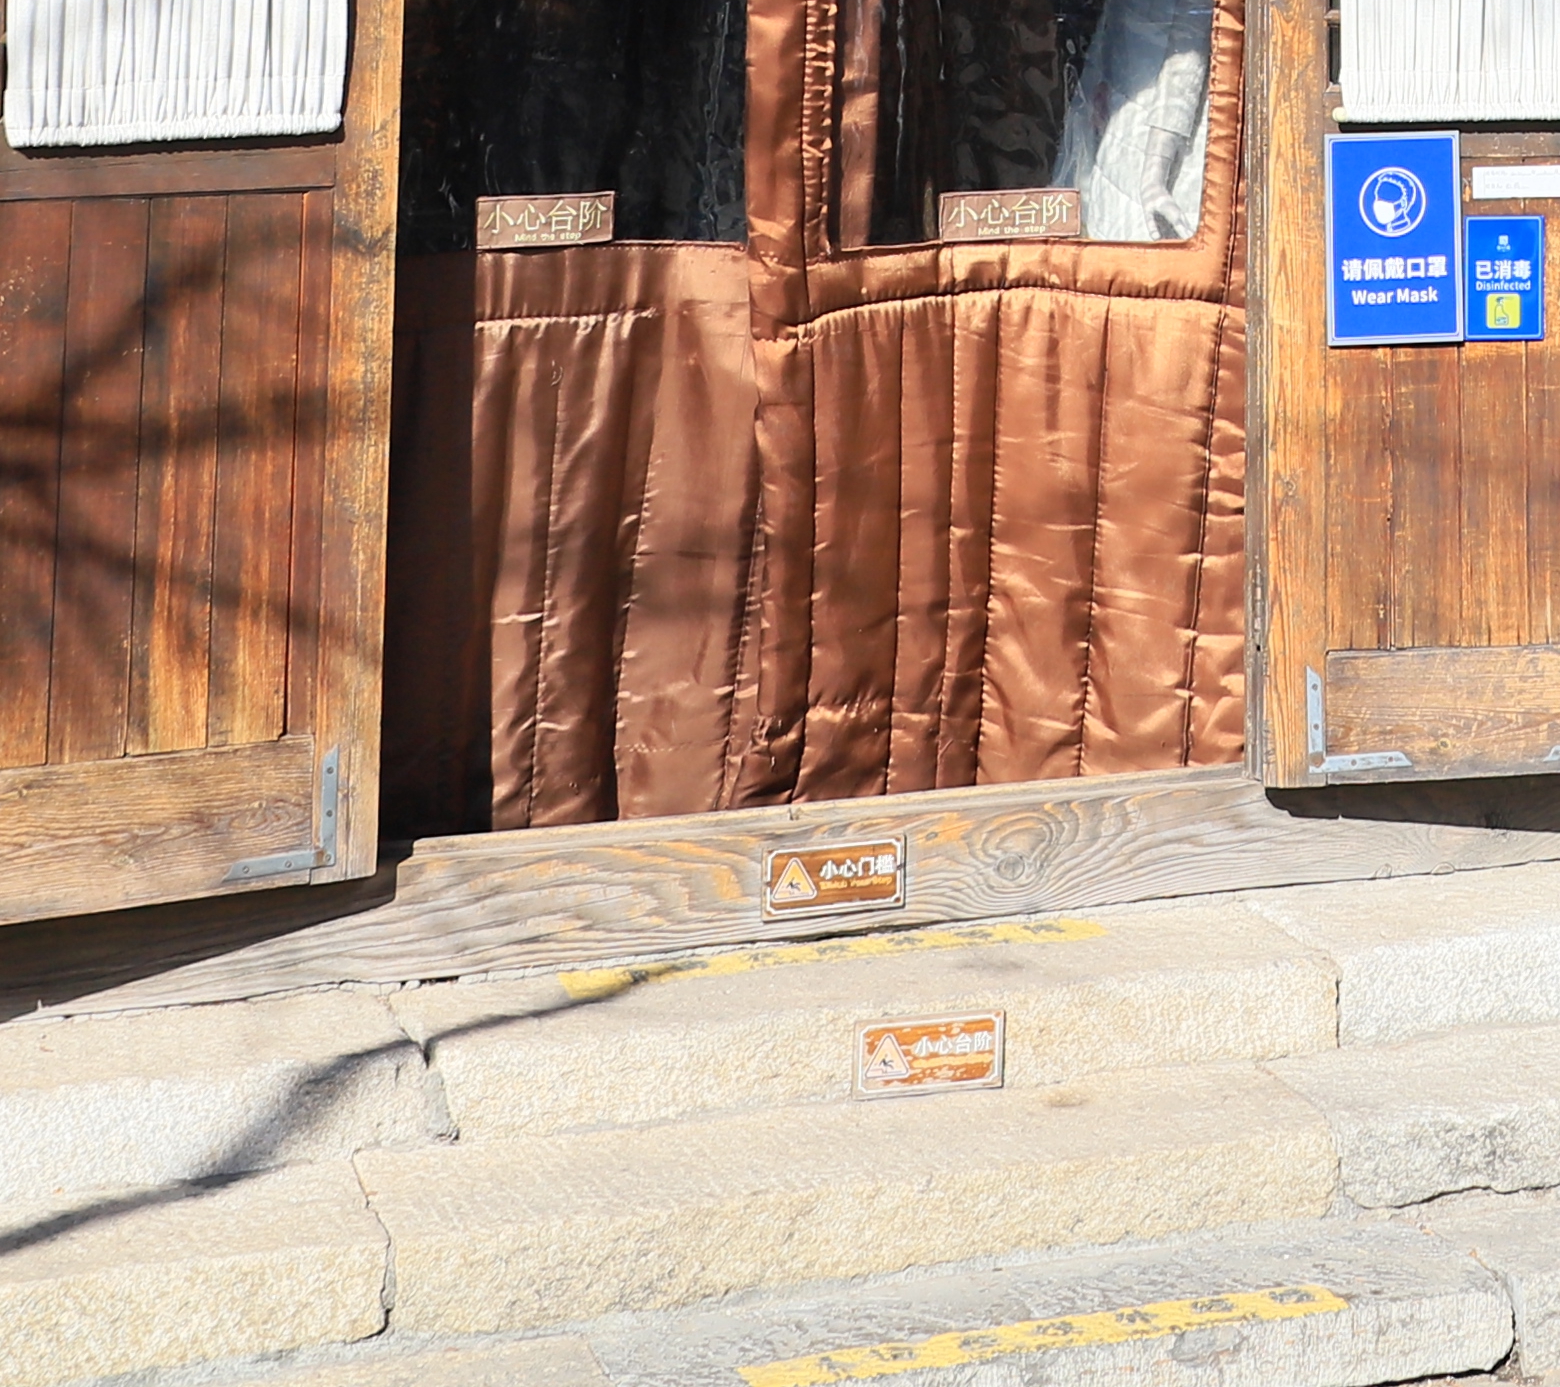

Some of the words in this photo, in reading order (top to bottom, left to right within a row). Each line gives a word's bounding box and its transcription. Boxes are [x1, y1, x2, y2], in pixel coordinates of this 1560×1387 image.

[483, 199, 608, 234] 小心台阶
[948, 193, 1073, 228] 小心台阶
[978, 227, 1000, 236] Mind
[1341, 255, 1448, 282] 请佩戴口罩
[1475, 260, 1532, 279] 已消毒
[1351, 289, 1394, 306] Wear
[1396, 286, 1439, 304] Mask
[1475, 280, 1532, 291] Disinfected
[819, 854, 896, 880] 小心门槛
[914, 1031, 993, 1057] 小心台阶
